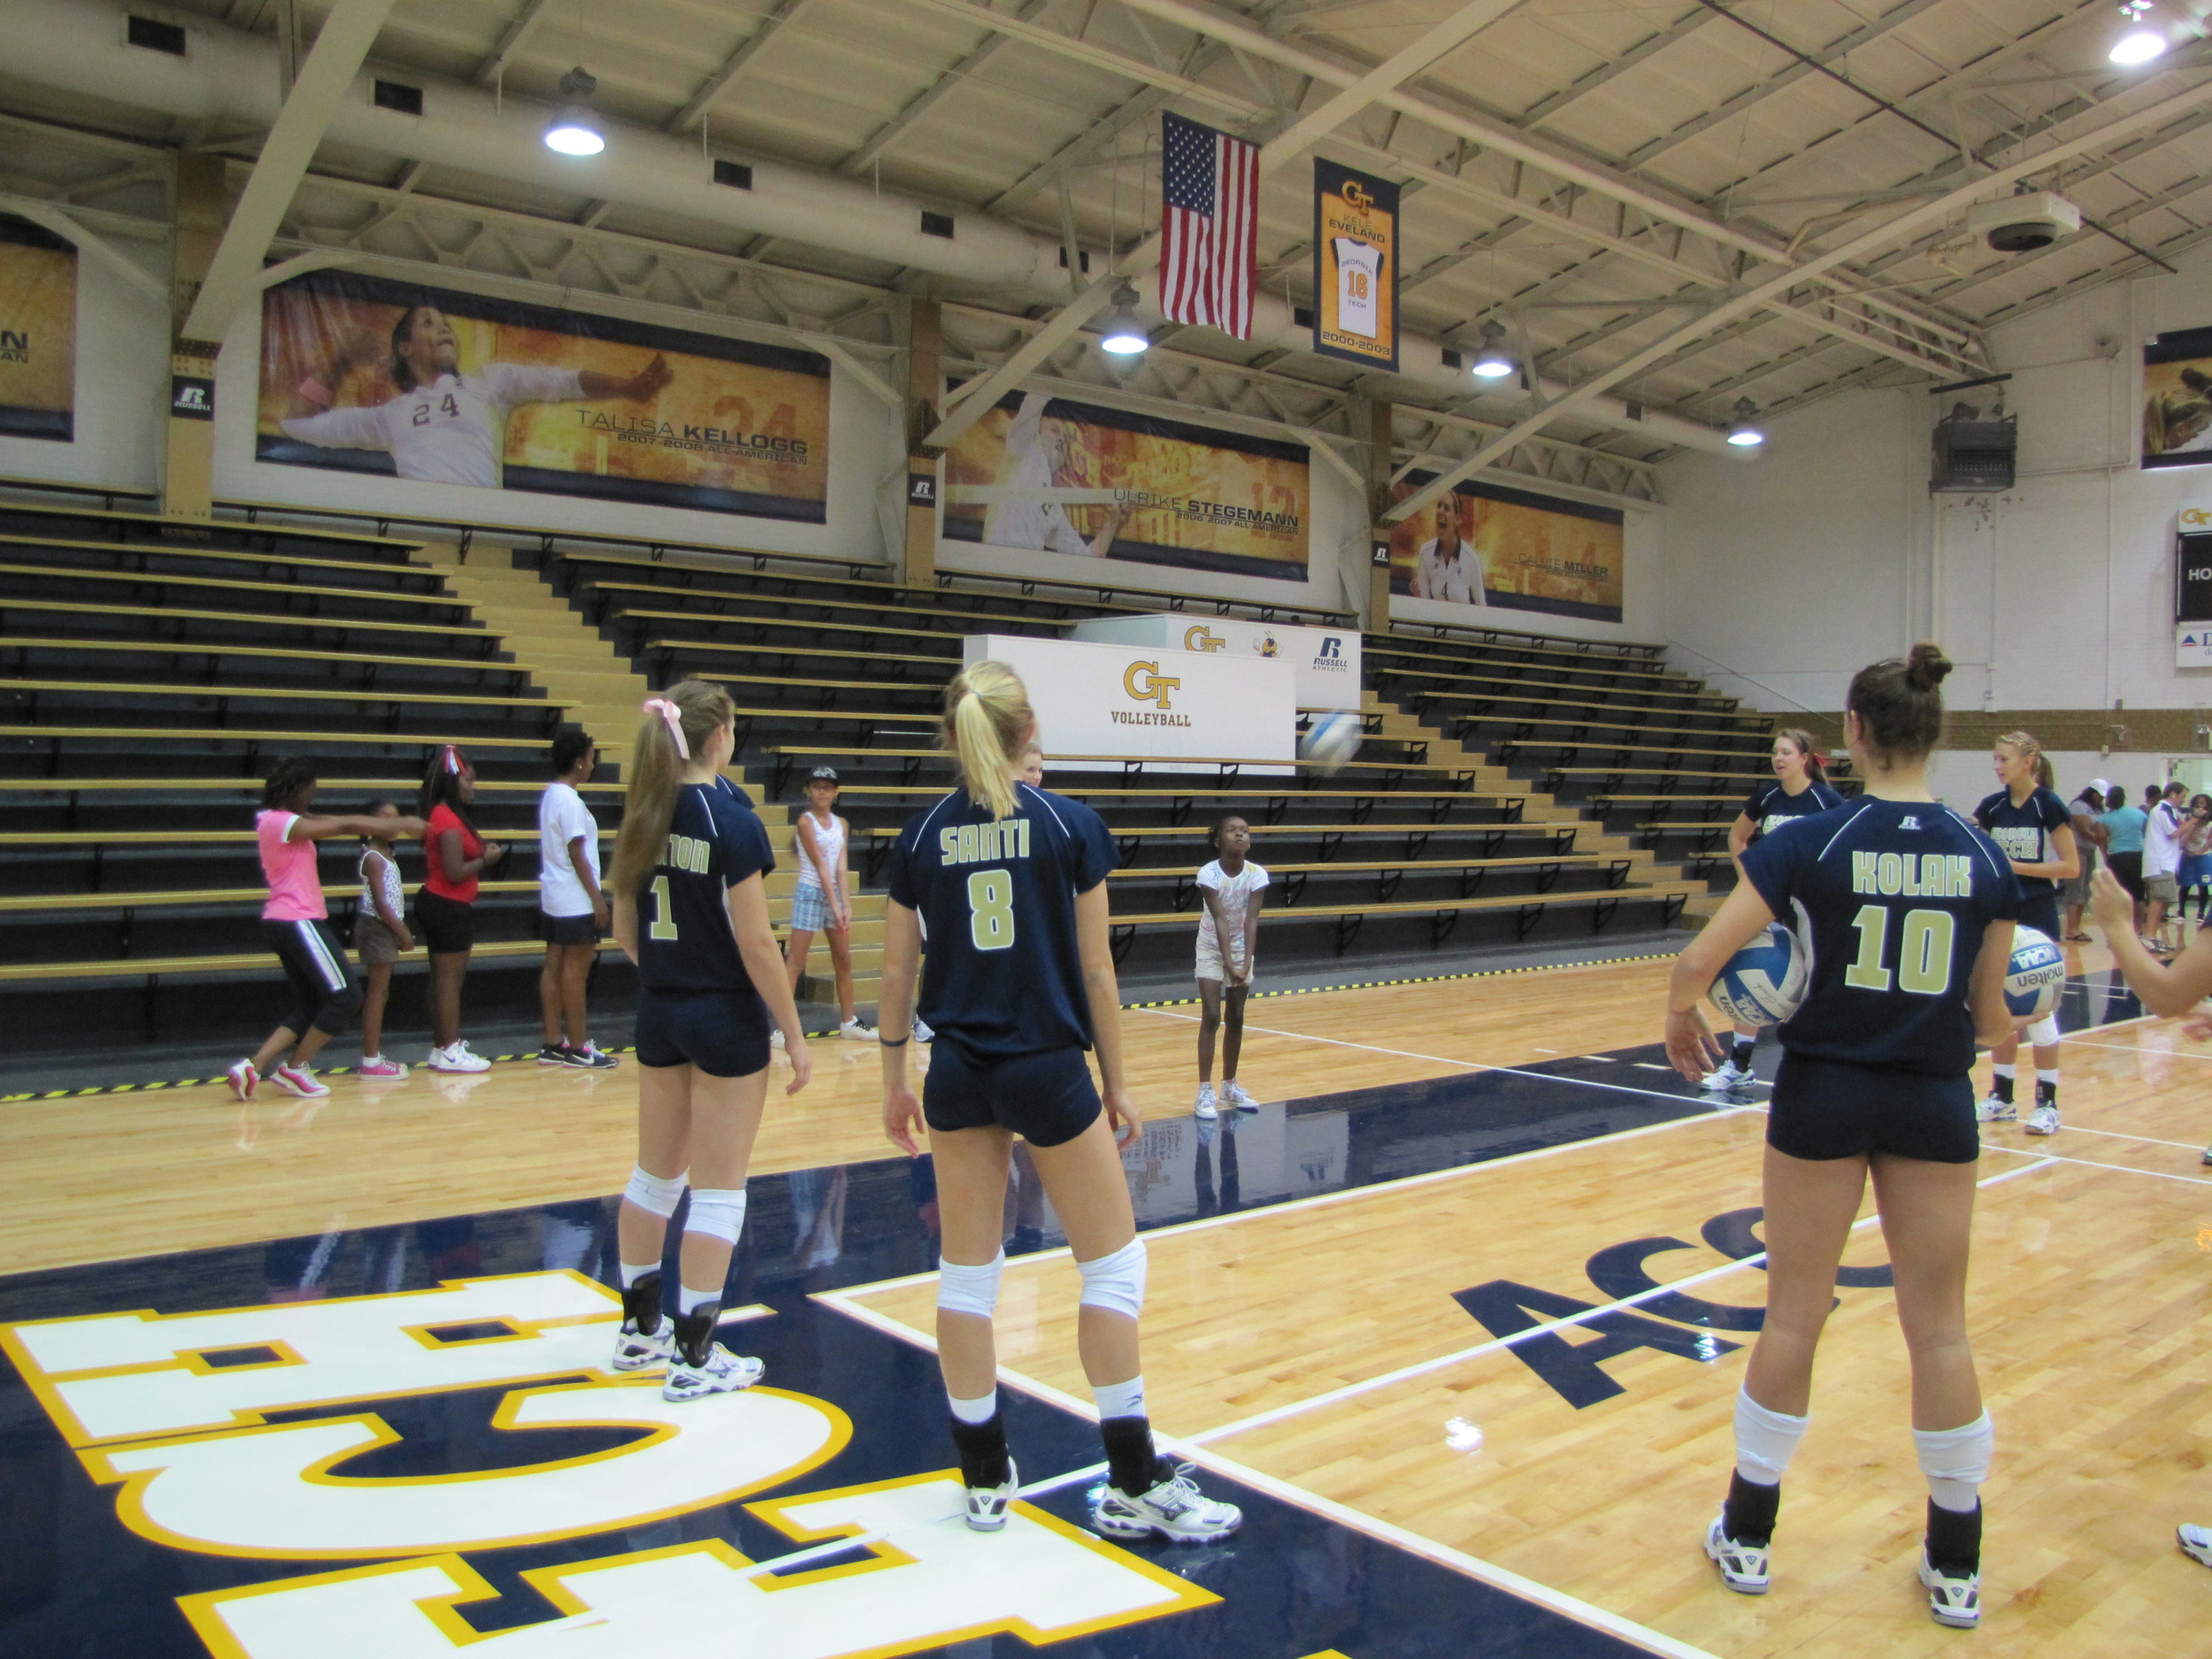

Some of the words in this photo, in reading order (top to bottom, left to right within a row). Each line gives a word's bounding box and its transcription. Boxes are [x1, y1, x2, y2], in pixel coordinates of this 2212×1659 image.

[1341, 180, 1374, 217] GT
[1329, 219, 1386, 243] EVELAND
[1341, 258, 1373, 276] GEORGIA
[1348, 301, 1366, 310] TECH
[1323, 331, 1391, 356] 2000-2003
[174, 401, 211, 411] RUSSELL
[413, 393, 460, 427] 24
[575, 409, 675, 438] TALISA
[684, 424, 808, 456] KELLOGG
[618, 433, 656, 445] 2007
[664, 439, 703, 451] 2008
[708, 444, 808, 465] ALL-AMERICAN
[1114, 488, 1181, 511] ULRIKE
[1187, 499, 1299, 527] STEGEMANN
[1209, 517, 1232, 526] 2007
[1233, 520, 1299, 536] ALL-AMERICAN
[1563, 560, 1609, 576] MILLER
[1313, 657, 1348, 668] RUSSELL
[1319, 636, 1341, 658] R
[1123, 660, 1180, 710] GT
[1111, 710, 1192, 727] VOLLEYBALL
[659, 833, 710, 875] TON
[940, 818, 1030, 866] SANTI
[1852, 850, 1971, 897] KOLAK
[649, 874, 679, 941] 1
[967, 868, 1016, 951] 8
[1844, 903, 1955, 995] 10
[2016, 964, 2063, 987] molten
